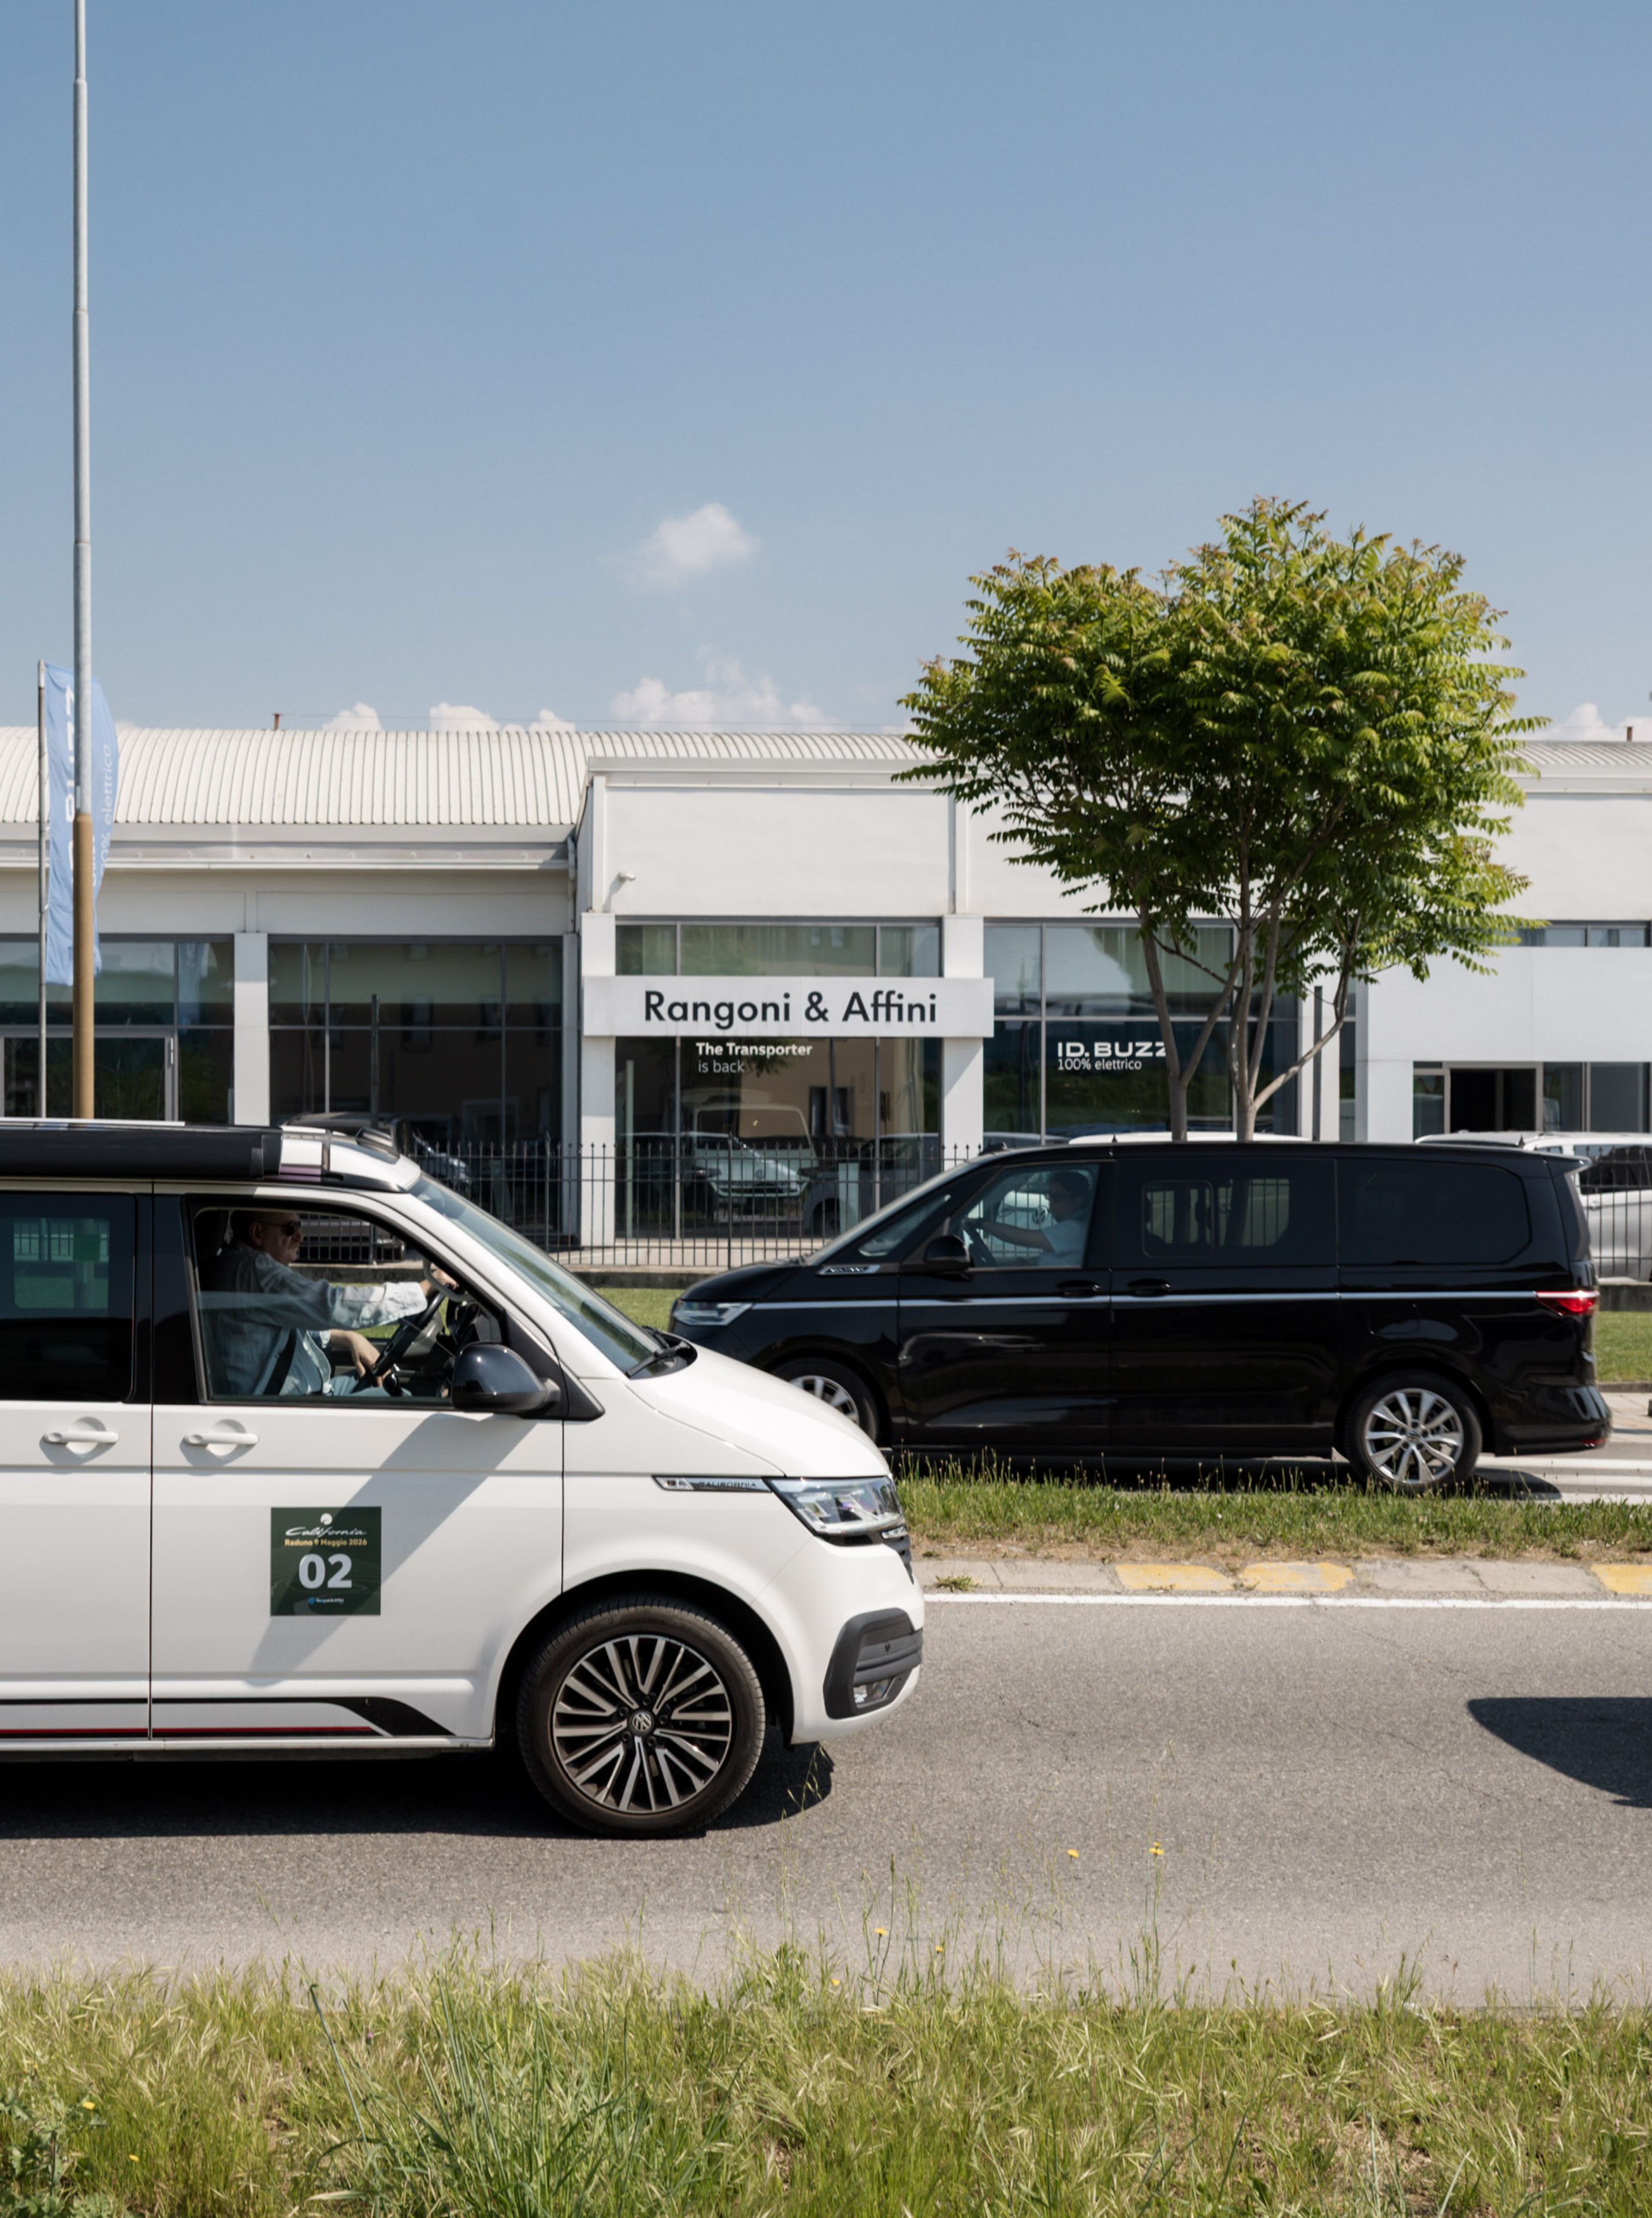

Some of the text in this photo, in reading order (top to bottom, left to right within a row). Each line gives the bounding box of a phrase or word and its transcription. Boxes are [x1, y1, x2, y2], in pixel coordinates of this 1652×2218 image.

[101, 743, 113, 825] elettrico
[645, 990, 936, 1030] Rangoni & Affini
[695, 1043, 812, 1059] The Transporter
[698, 1060, 744, 1073] is back
[1058, 1058, 1142, 1070] 100% elettrico
[285, 1526, 367, 1538] California
[284, 1538, 313, 1546] Raduno
[321, 1538, 347, 1547] Maggio
[298, 1553, 352, 1589] 02
